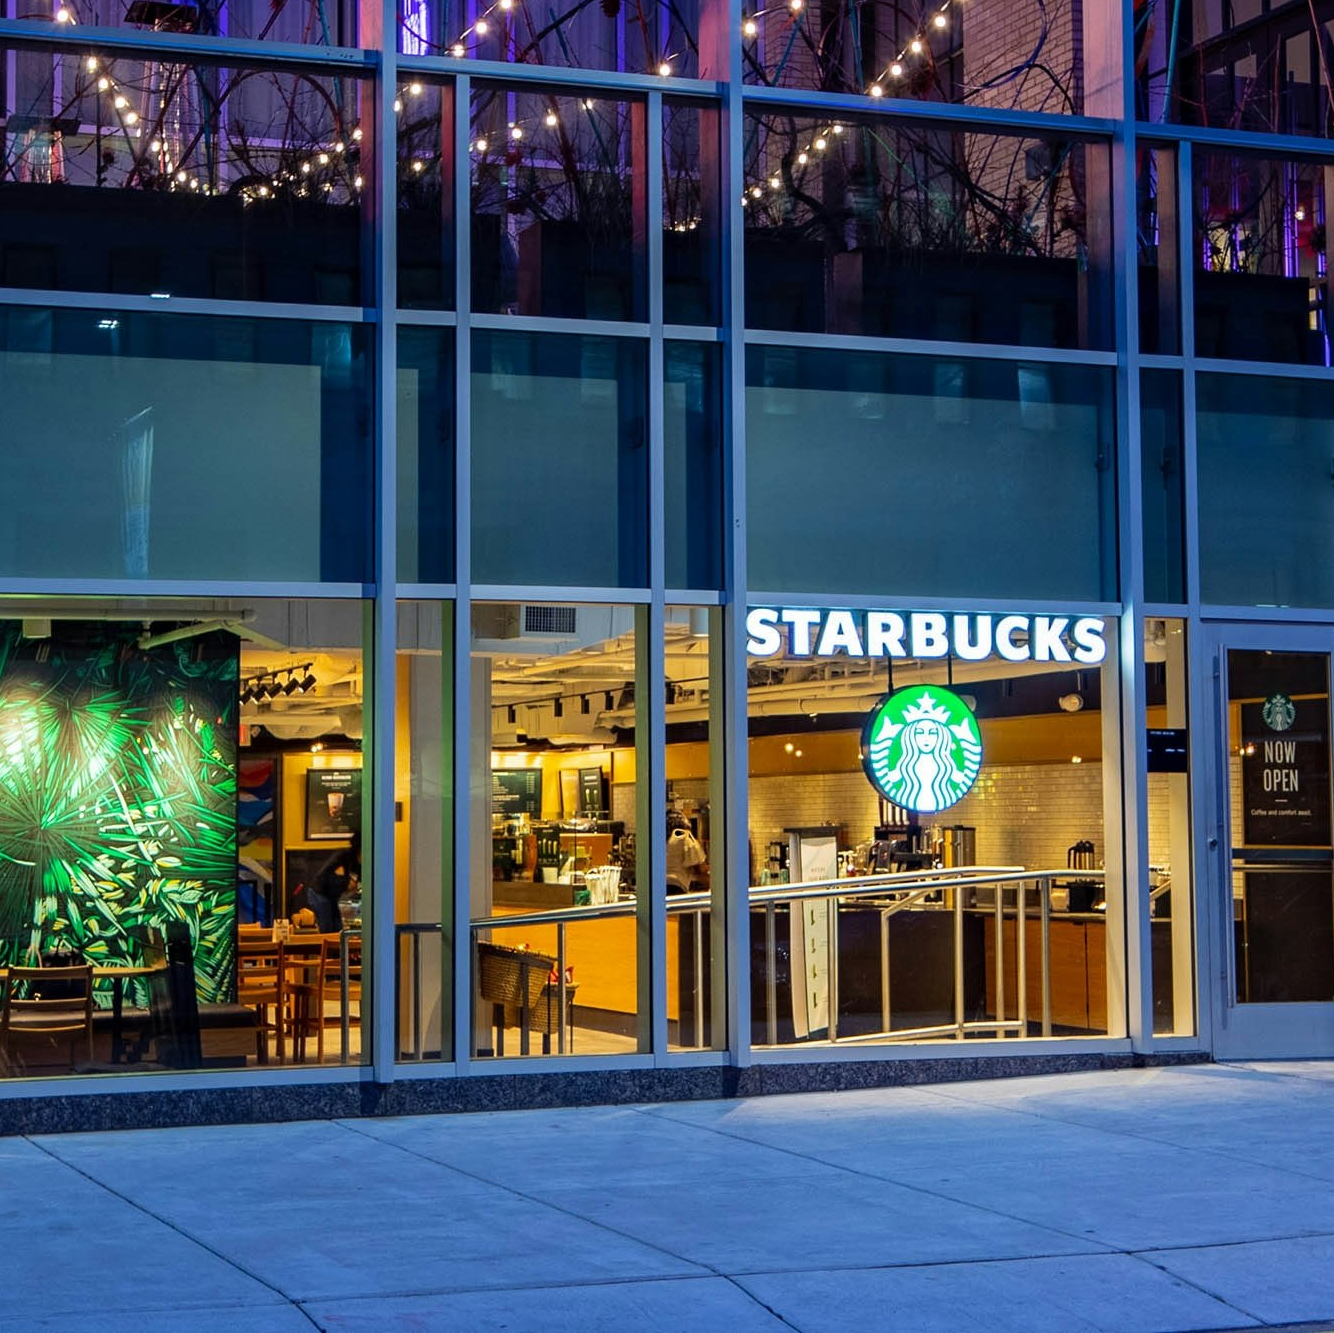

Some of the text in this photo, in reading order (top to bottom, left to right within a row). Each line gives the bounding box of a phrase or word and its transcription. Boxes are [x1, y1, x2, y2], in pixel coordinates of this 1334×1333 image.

[746, 608, 1107, 664] STARBUCKS
[1264, 740, 1296, 764] NOW
[1263, 769, 1299, 792] OPEN
